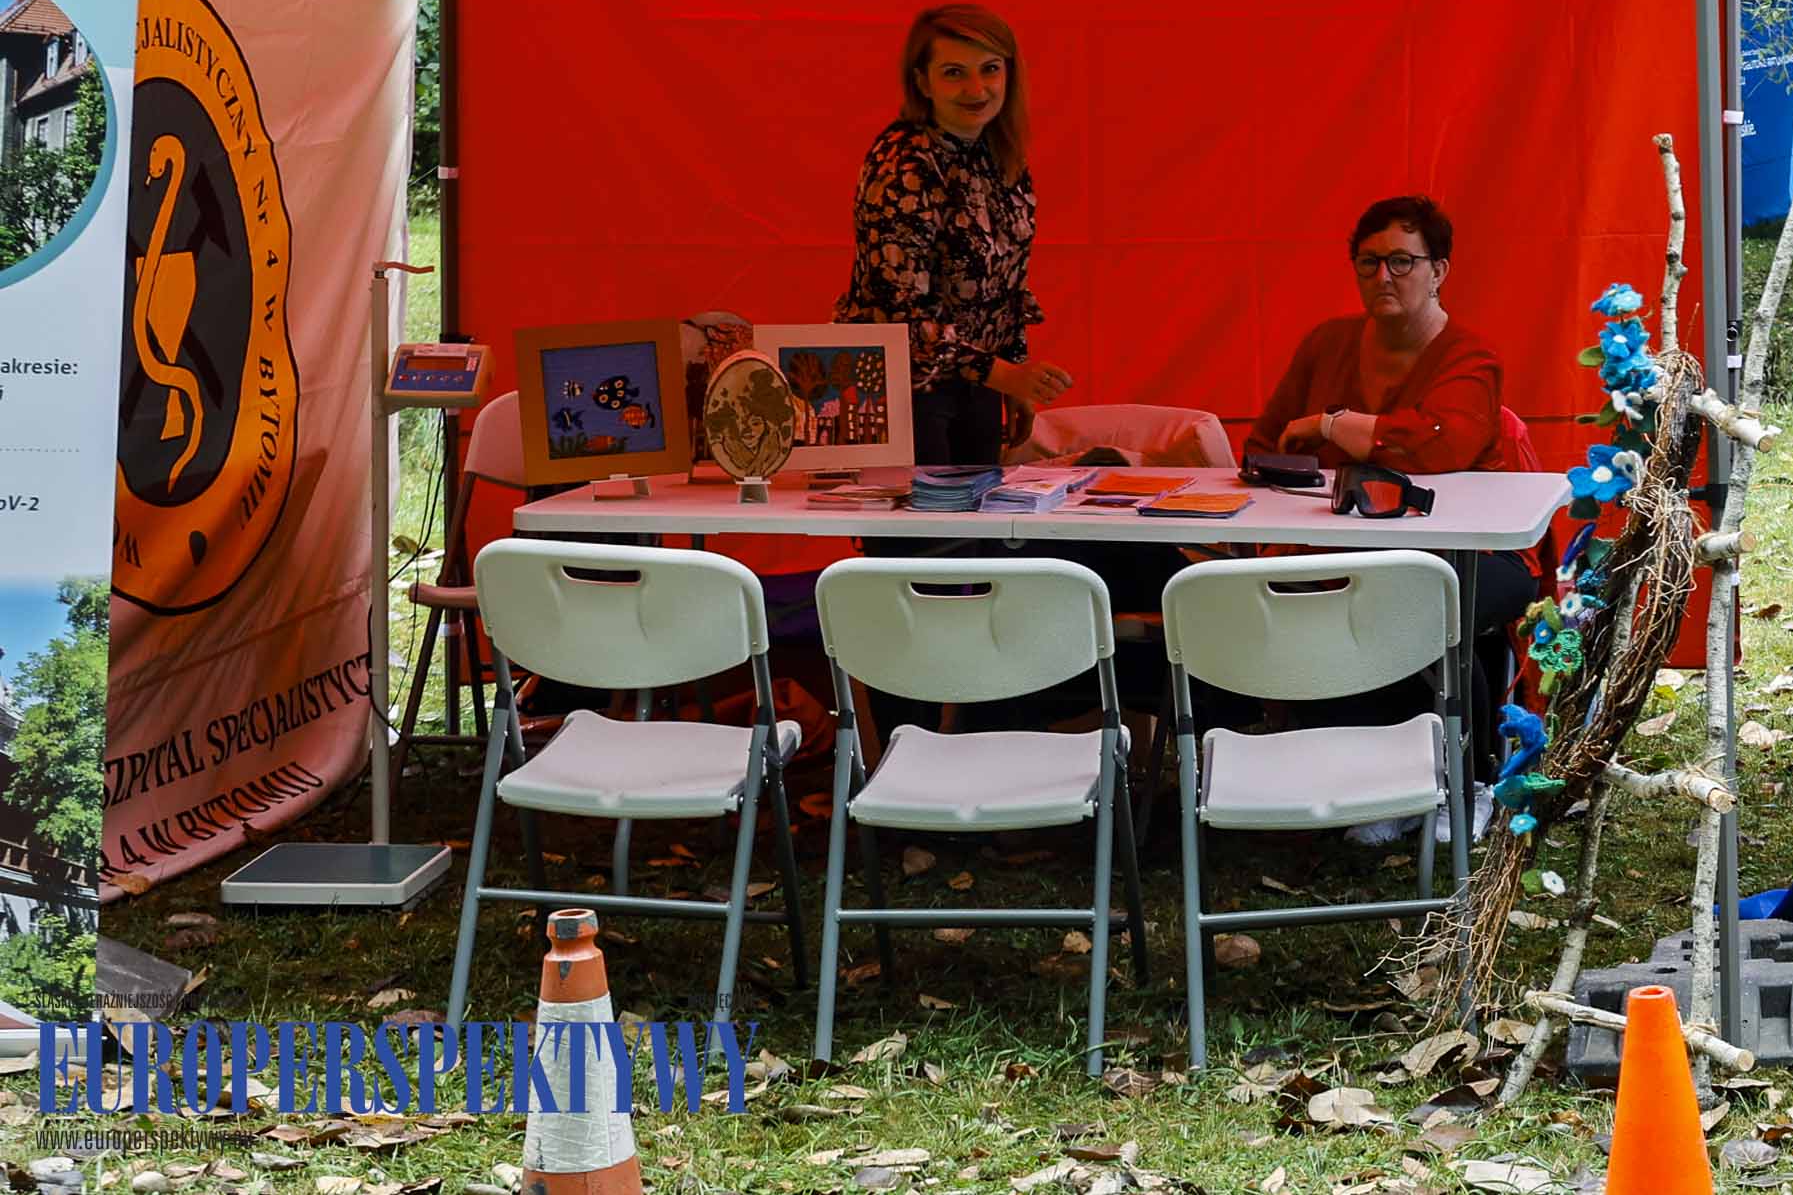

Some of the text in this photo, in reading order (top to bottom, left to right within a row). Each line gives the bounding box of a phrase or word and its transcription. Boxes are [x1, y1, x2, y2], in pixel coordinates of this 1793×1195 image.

[134, 15, 256, 160] JALISTYCZNY
[120, 835, 156, 866] 4
[176, 761, 323, 841] BYTOMIU
